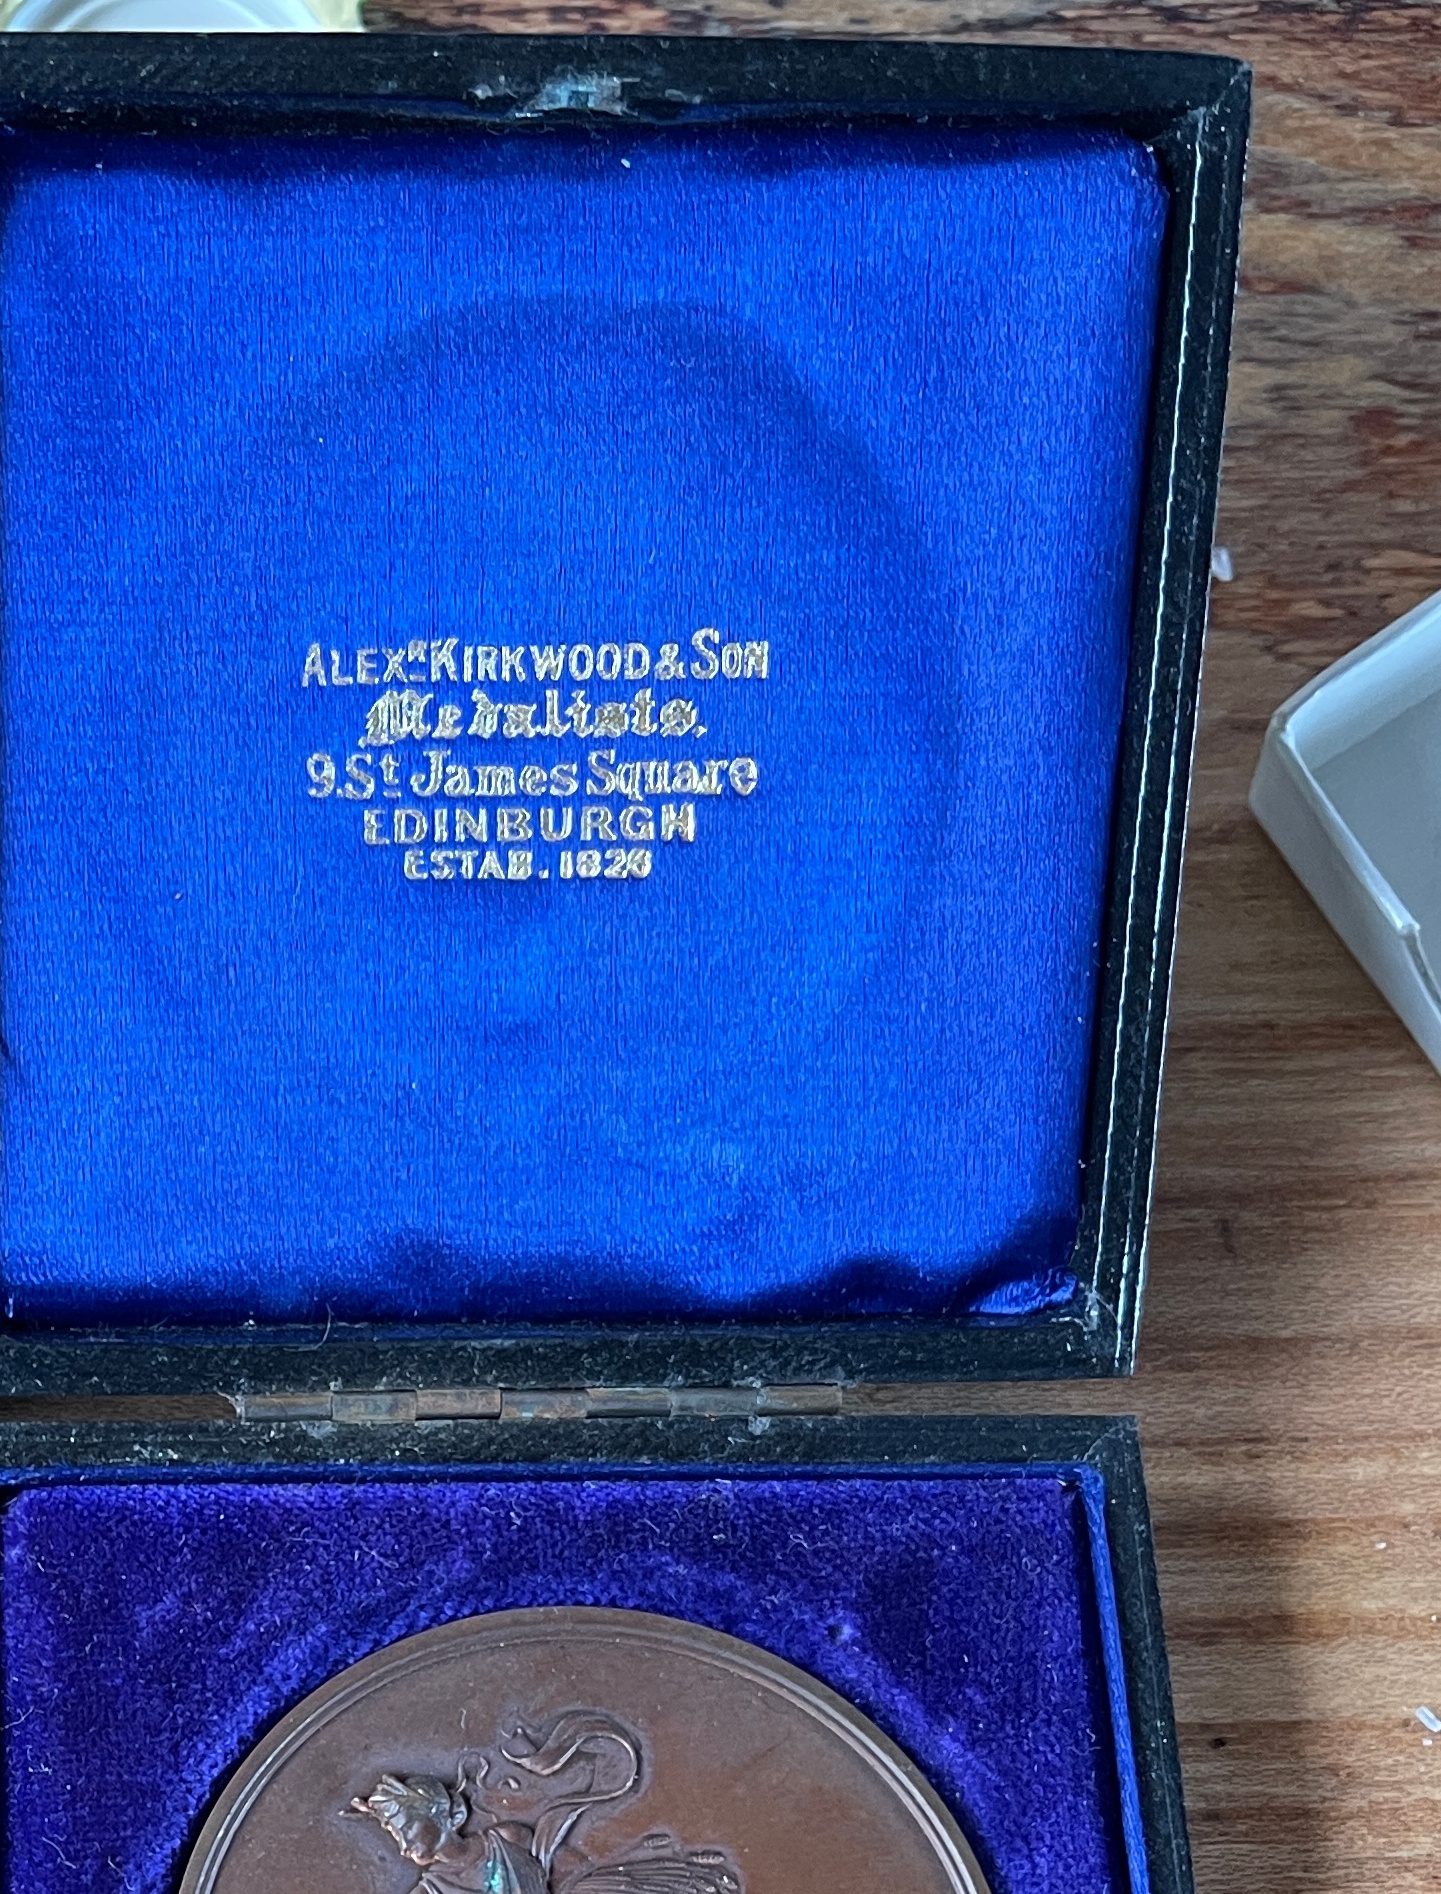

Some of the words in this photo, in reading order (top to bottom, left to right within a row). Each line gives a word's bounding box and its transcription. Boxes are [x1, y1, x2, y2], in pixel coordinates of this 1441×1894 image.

[430, 637, 651, 684] KIRKWOOD
[654, 642, 686, 681] &
[410, 749, 578, 798] James
[587, 748, 759, 802] Square
[363, 802, 696, 845] EDINBURGH
